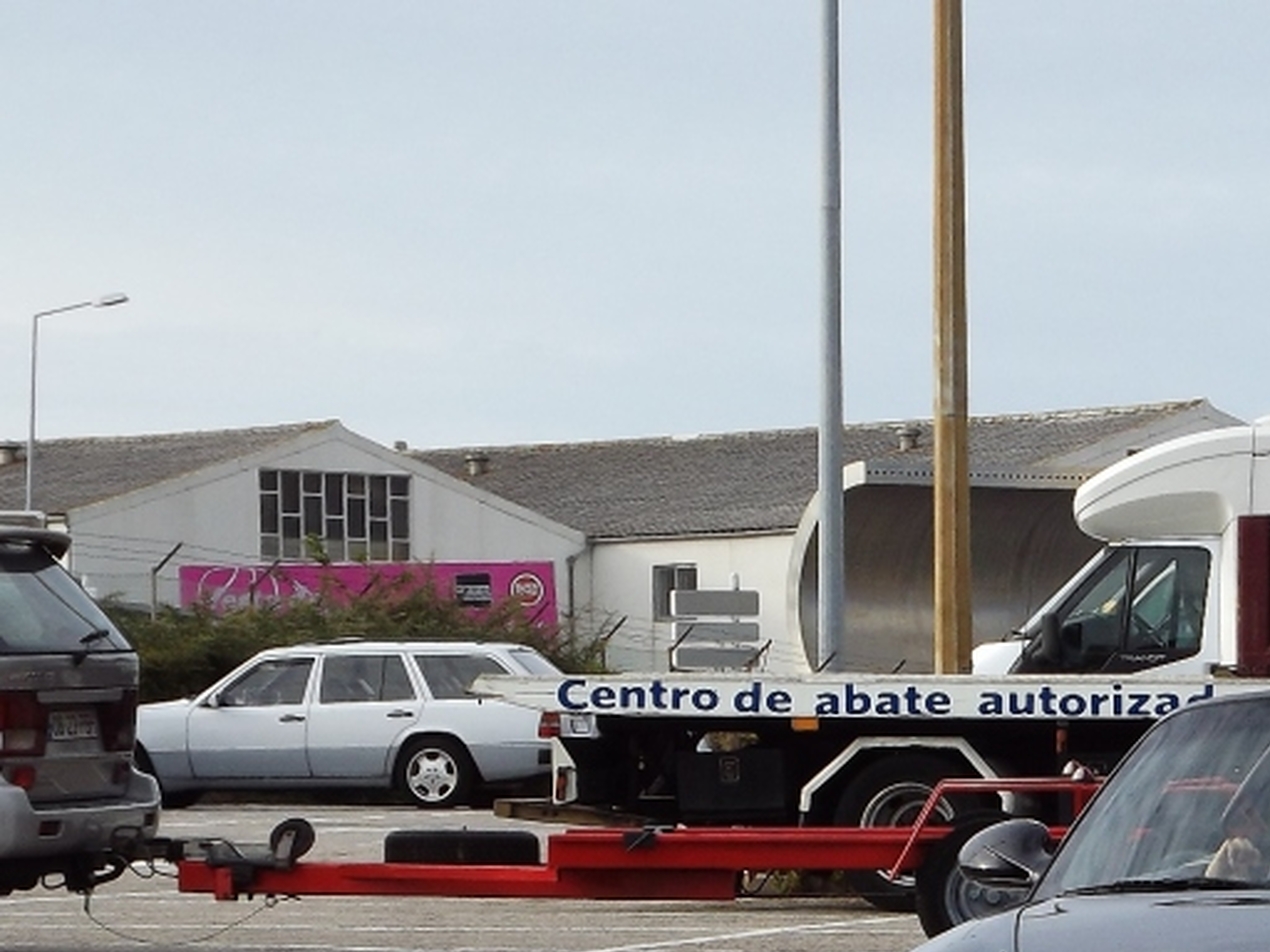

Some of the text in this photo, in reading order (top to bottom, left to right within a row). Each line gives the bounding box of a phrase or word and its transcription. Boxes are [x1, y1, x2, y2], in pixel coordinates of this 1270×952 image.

[557, 679, 720, 711] Centro
[734, 682, 793, 714] de
[815, 683, 951, 716] abate
